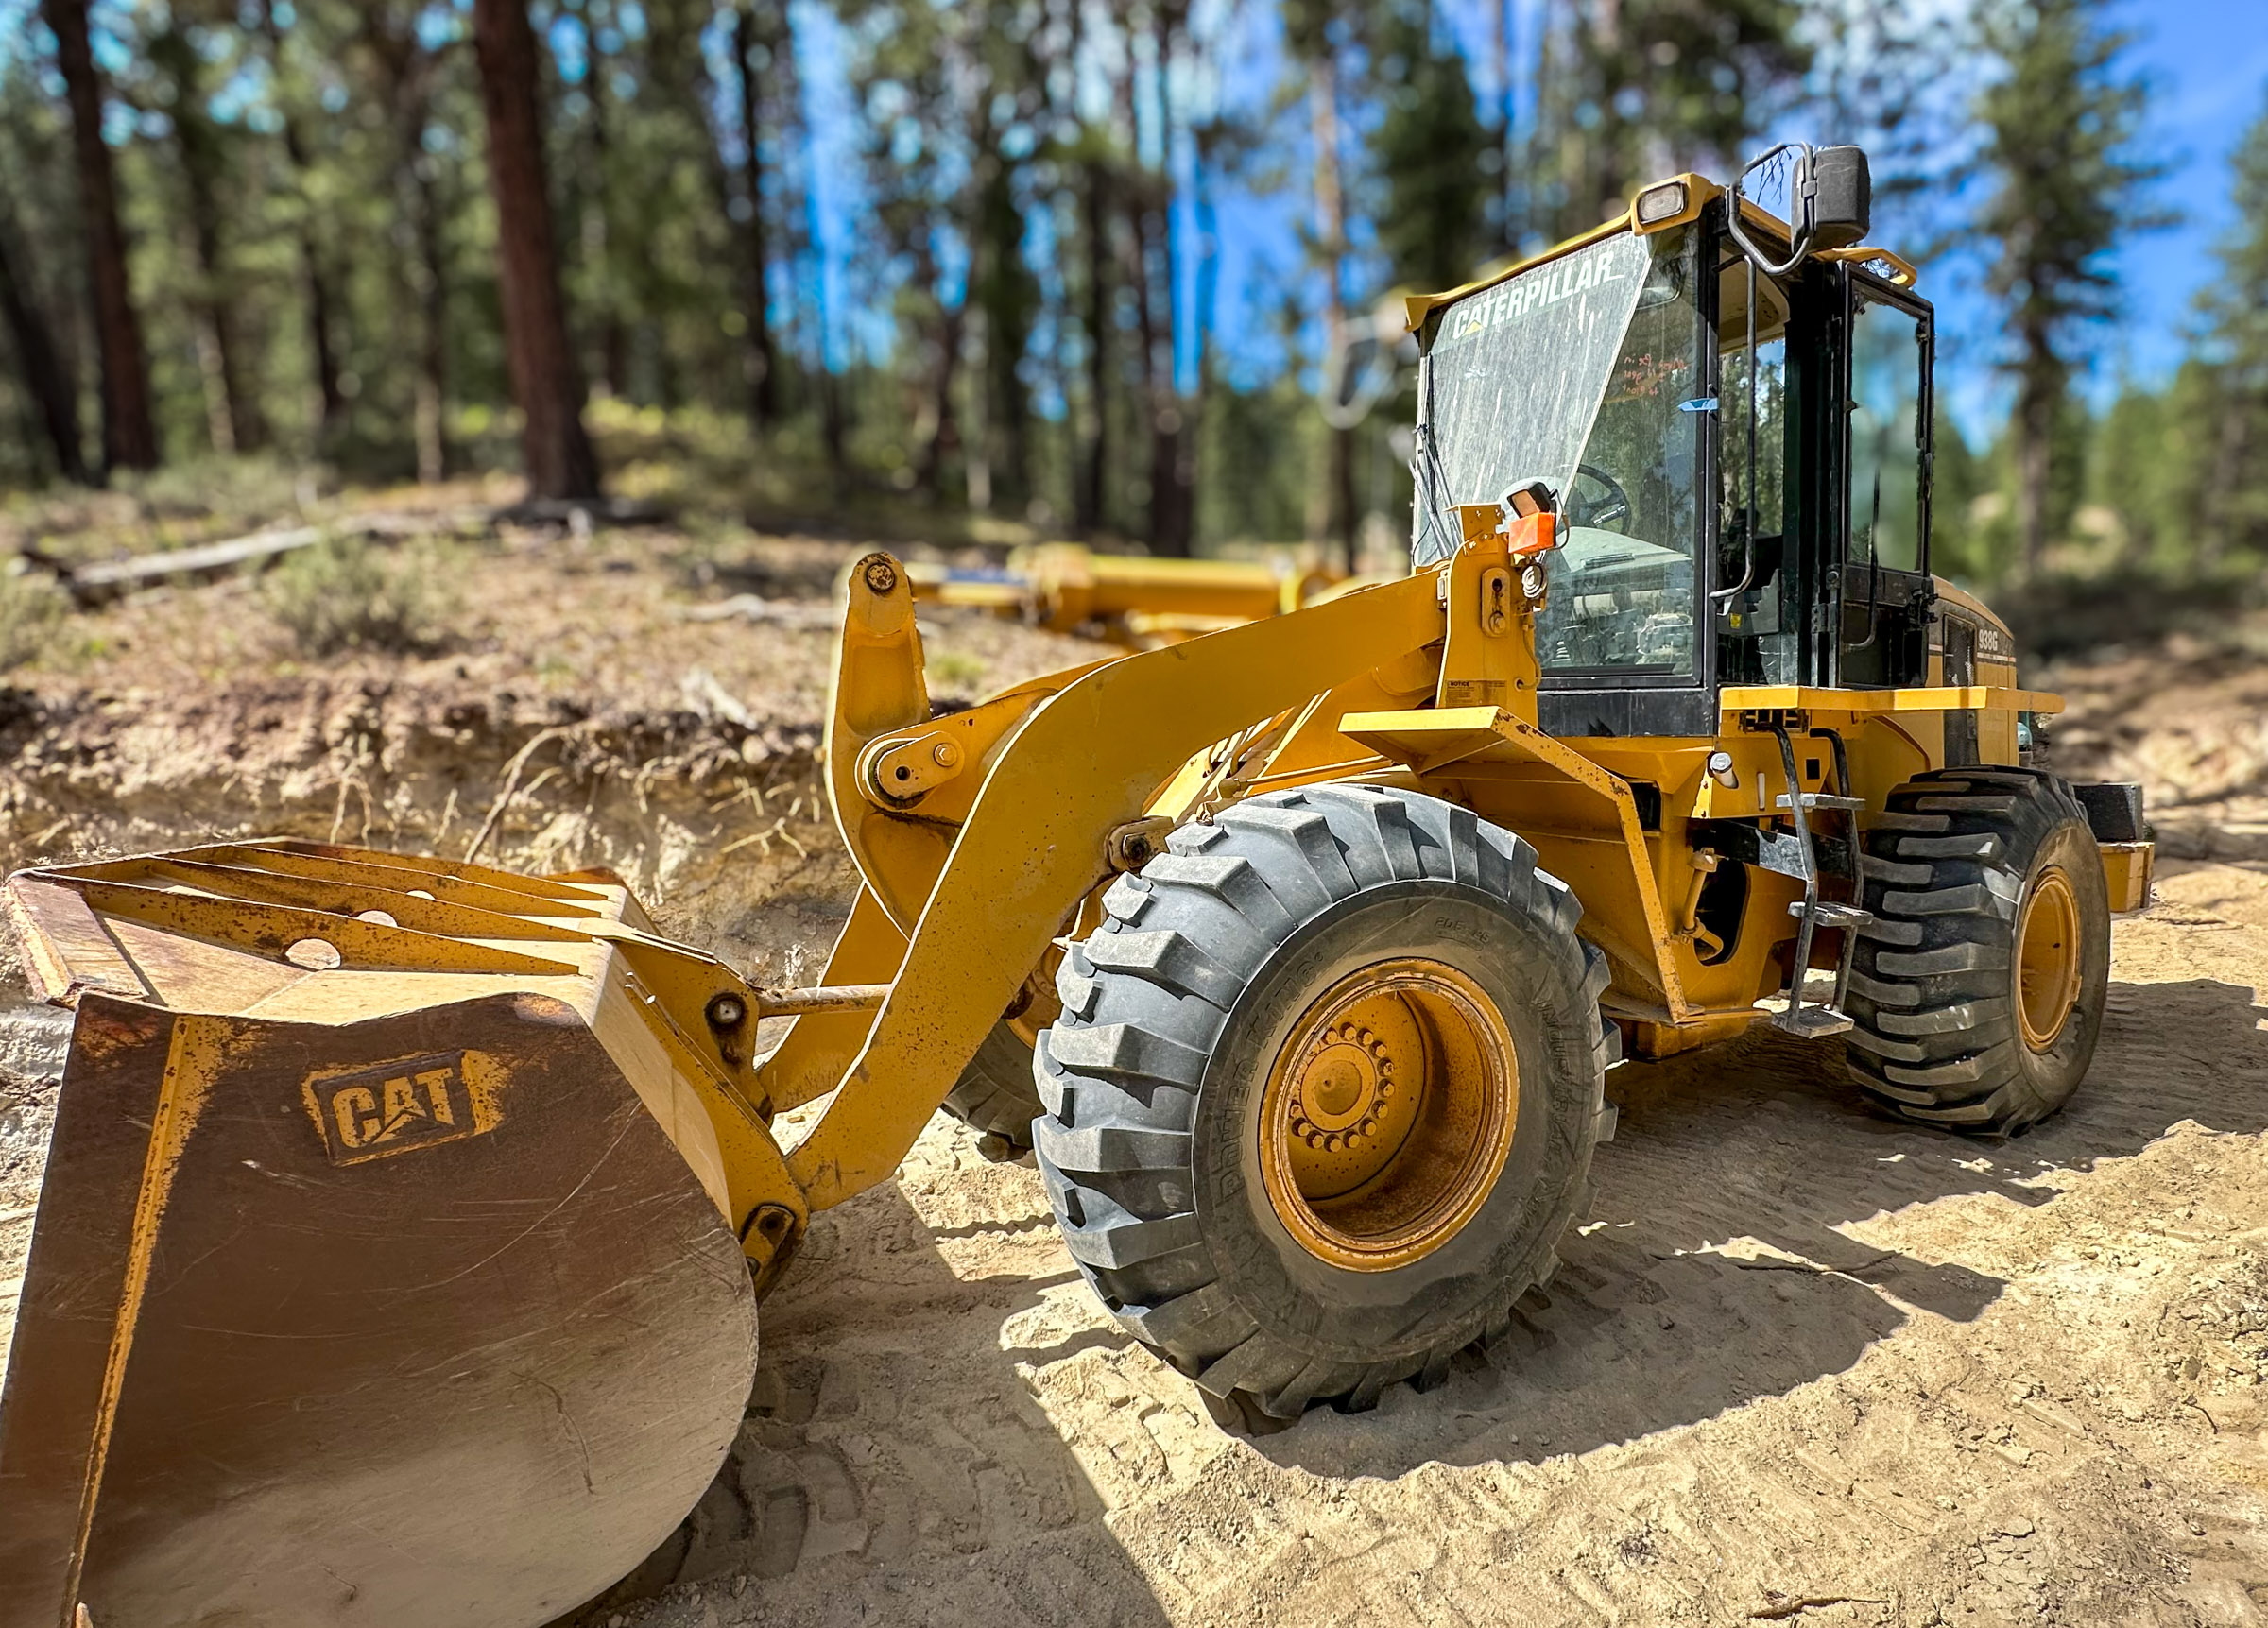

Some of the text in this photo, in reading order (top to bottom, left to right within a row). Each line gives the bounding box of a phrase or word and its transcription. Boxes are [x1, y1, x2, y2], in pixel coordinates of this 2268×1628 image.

[1453, 252, 1624, 339] CATERPILLAR
[1979, 629, 1999, 651] 938G
[333, 1068, 455, 1149] CAT
[1214, 1058, 1260, 1205] POWER
